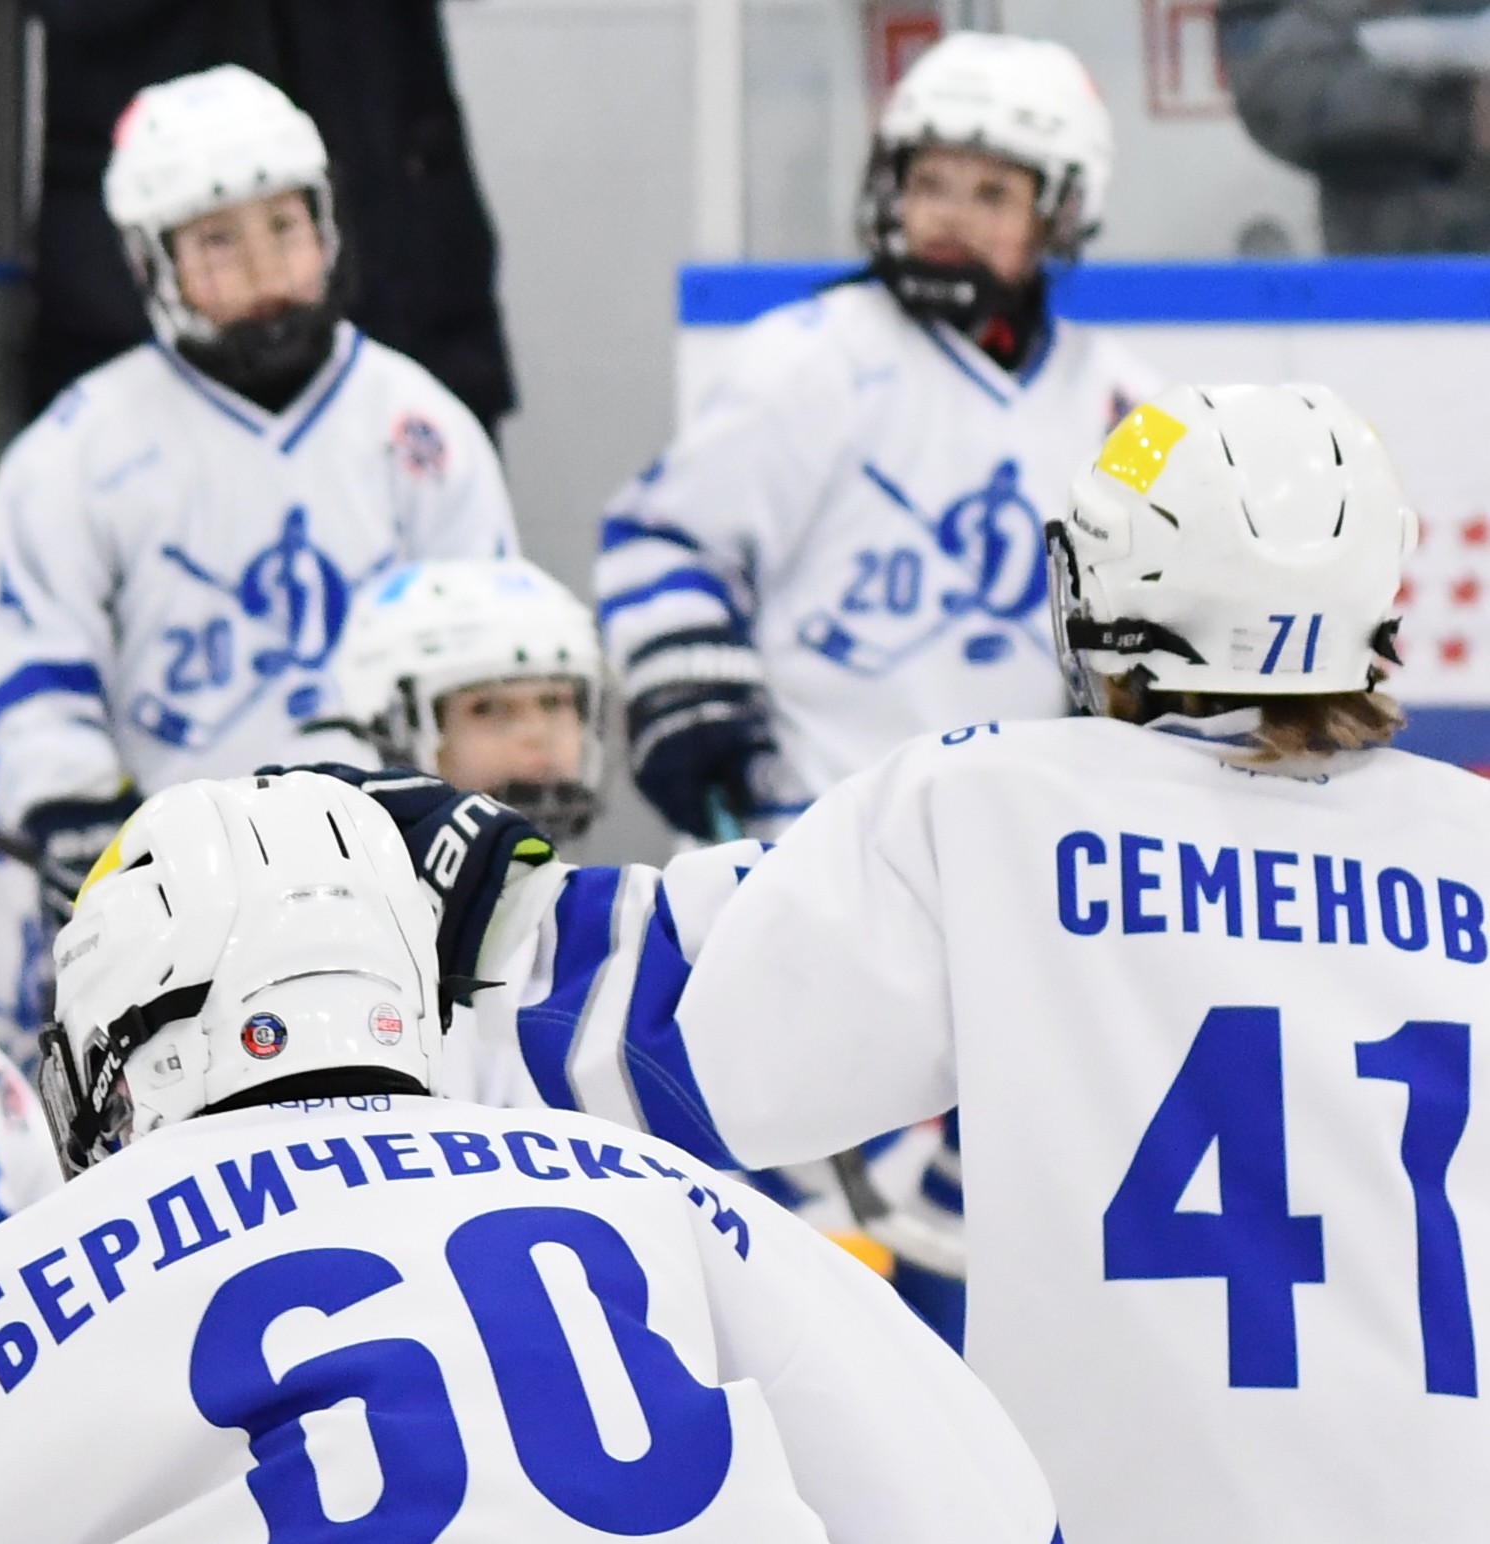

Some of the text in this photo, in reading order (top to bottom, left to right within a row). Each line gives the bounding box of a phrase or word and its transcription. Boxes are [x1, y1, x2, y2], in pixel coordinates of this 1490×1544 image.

[1259, 612, 1323, 675] 71
[1055, 830, 1488, 965] СЕМЕНОВ
[1102, 1005, 1481, 1400] 41
